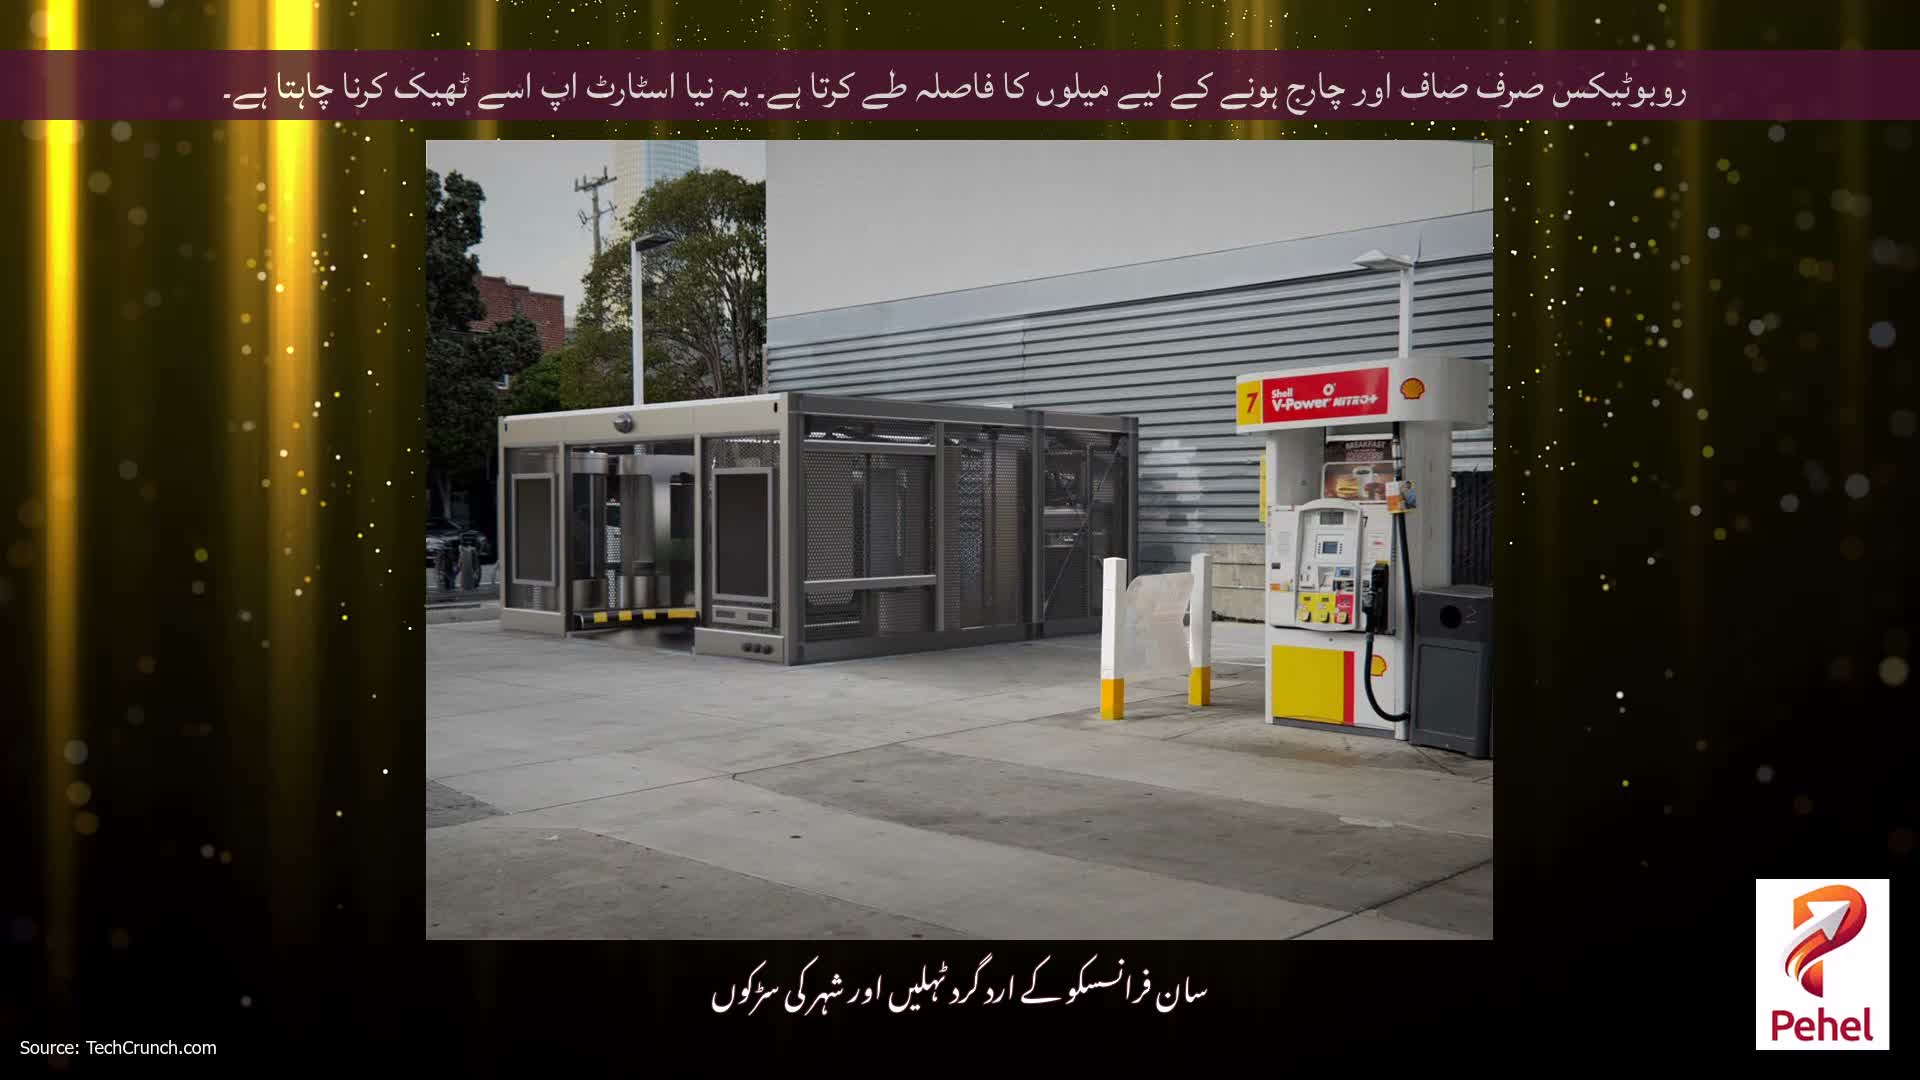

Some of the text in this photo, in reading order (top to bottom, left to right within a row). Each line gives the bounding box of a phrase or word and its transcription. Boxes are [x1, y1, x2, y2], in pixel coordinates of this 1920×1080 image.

[1271, 387, 1293, 399] Shell
[1246, 392, 1258, 413] 7
[1271, 397, 1329, 412] V-Power
